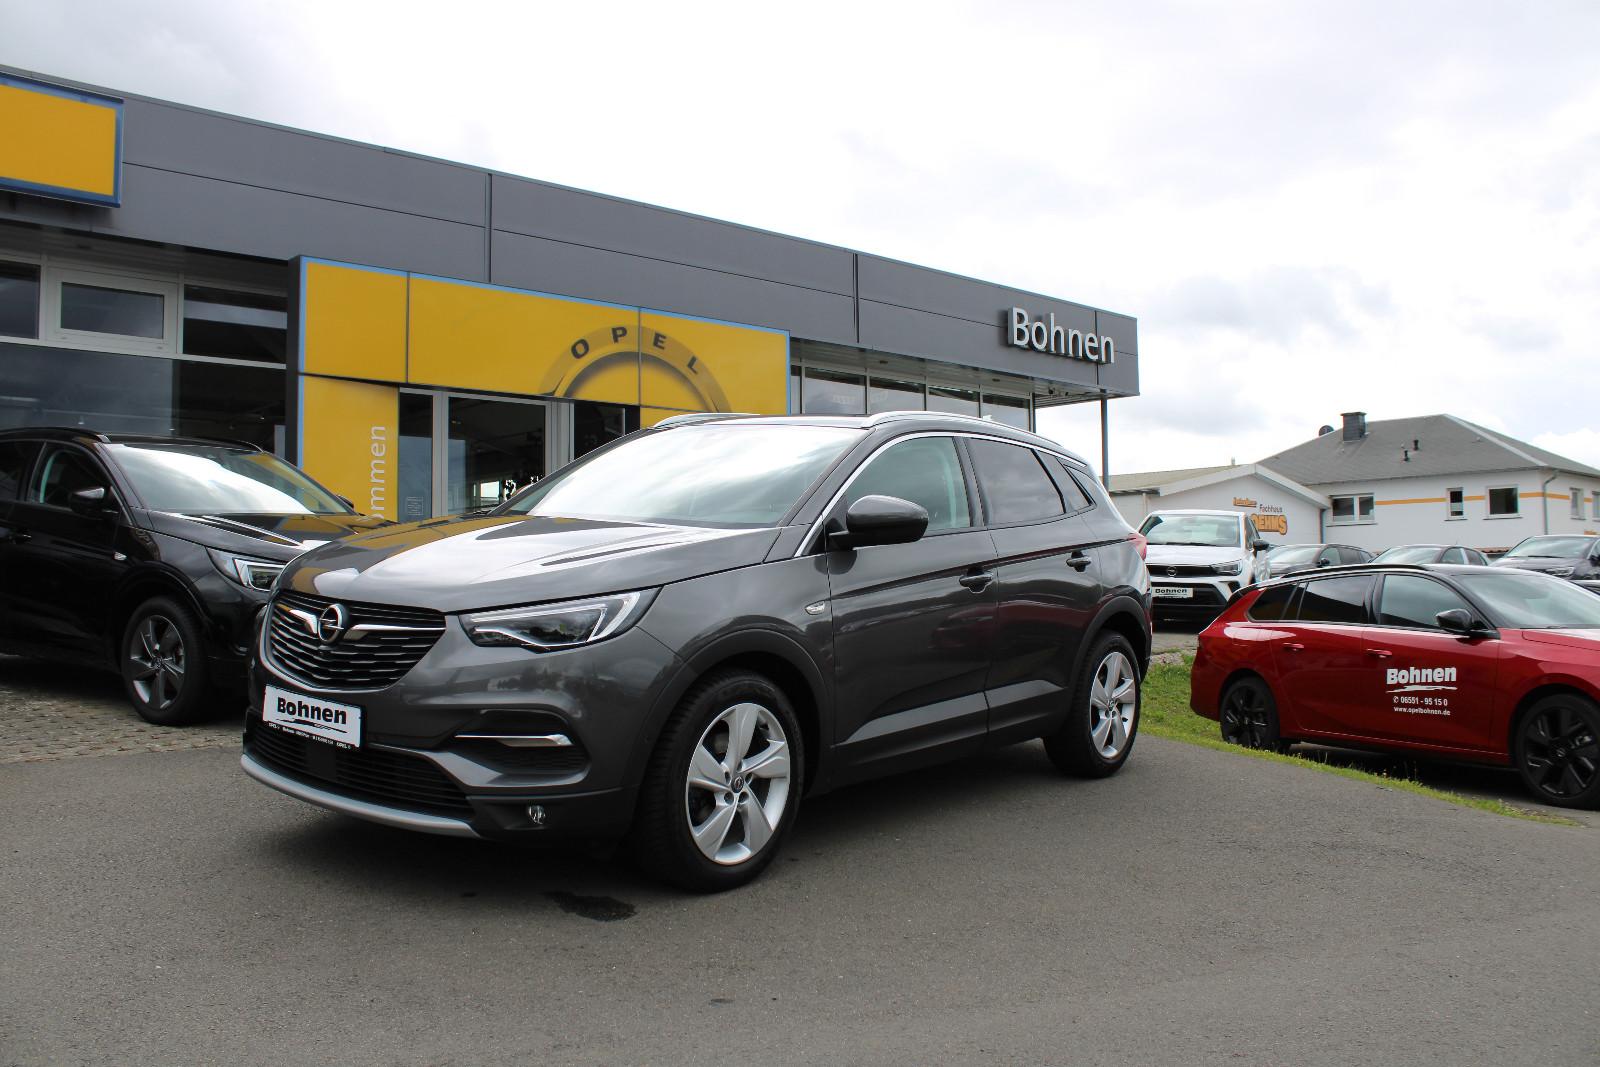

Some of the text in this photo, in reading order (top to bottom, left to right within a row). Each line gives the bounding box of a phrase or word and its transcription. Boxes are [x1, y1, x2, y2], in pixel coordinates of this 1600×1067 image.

[1010, 306, 1115, 364] Bohnen
[570, 326, 699, 375] OPEL
[1259, 503, 1283, 513] Fachhaus
[1386, 666, 1457, 685] Bohnen
[277, 696, 347, 725] Bohnen
[1400, 696, 1419, 704] 06551
[1424, 697, 1433, 705] 95
[1434, 698, 1443, 706] 15
[1443, 698, 1448, 706] 0
[1393, 706, 1451, 716] www.opelbohnen.de
